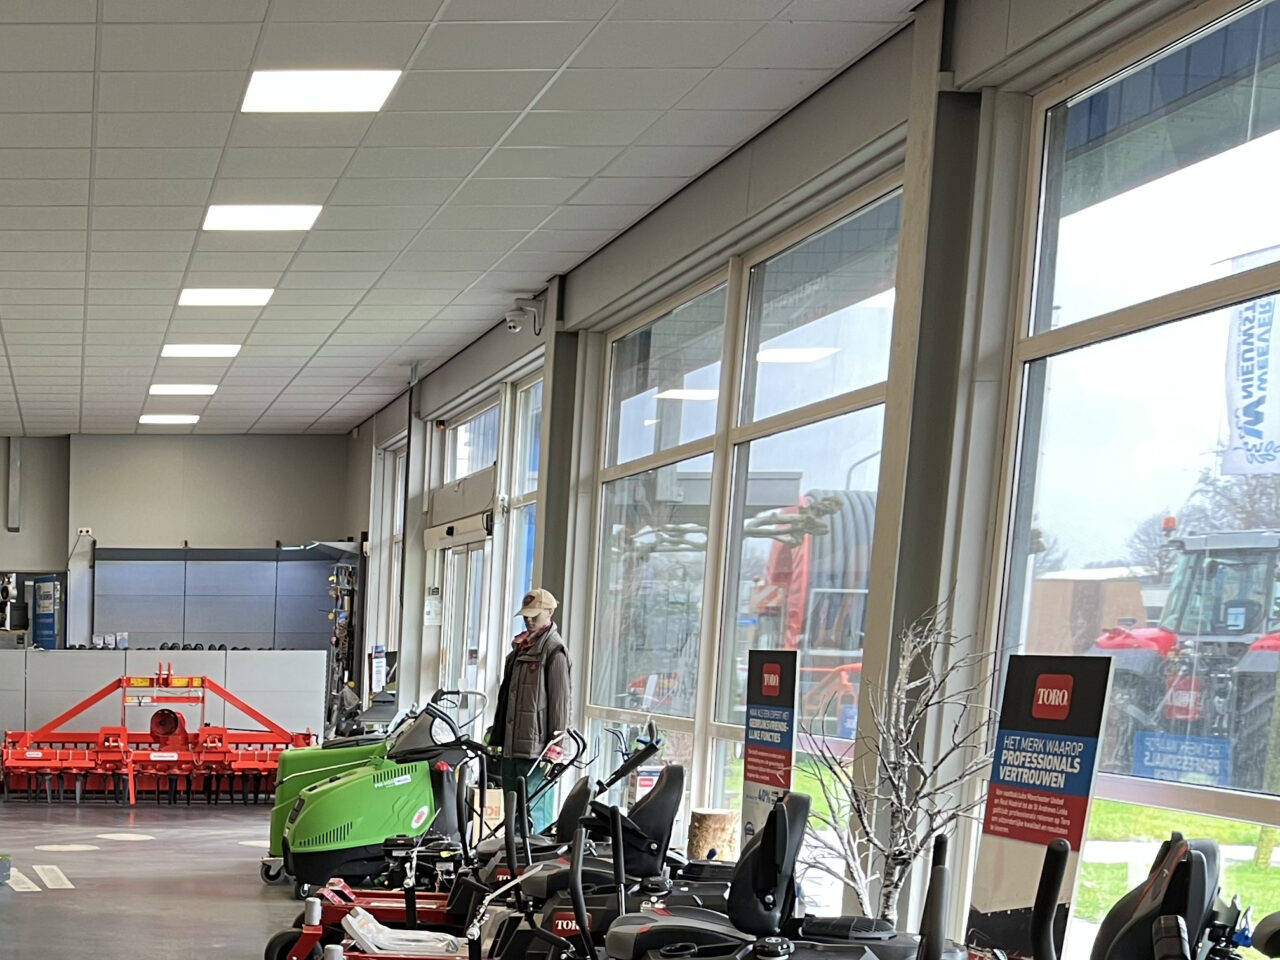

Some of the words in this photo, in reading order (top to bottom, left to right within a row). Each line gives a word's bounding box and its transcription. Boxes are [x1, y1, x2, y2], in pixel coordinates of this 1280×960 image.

[763, 673, 780, 687] TORO
[1037, 688, 1068, 706] TORO
[1003, 736, 1020, 749] HET
[1021, 737, 1045, 752] MERK
[1046, 740, 1083, 756] WAAROP
[1001, 750, 1081, 773] PROFESSIONALS
[999, 766, 1066, 788] VERTROUWEN
[556, 920, 581, 931] TOR
